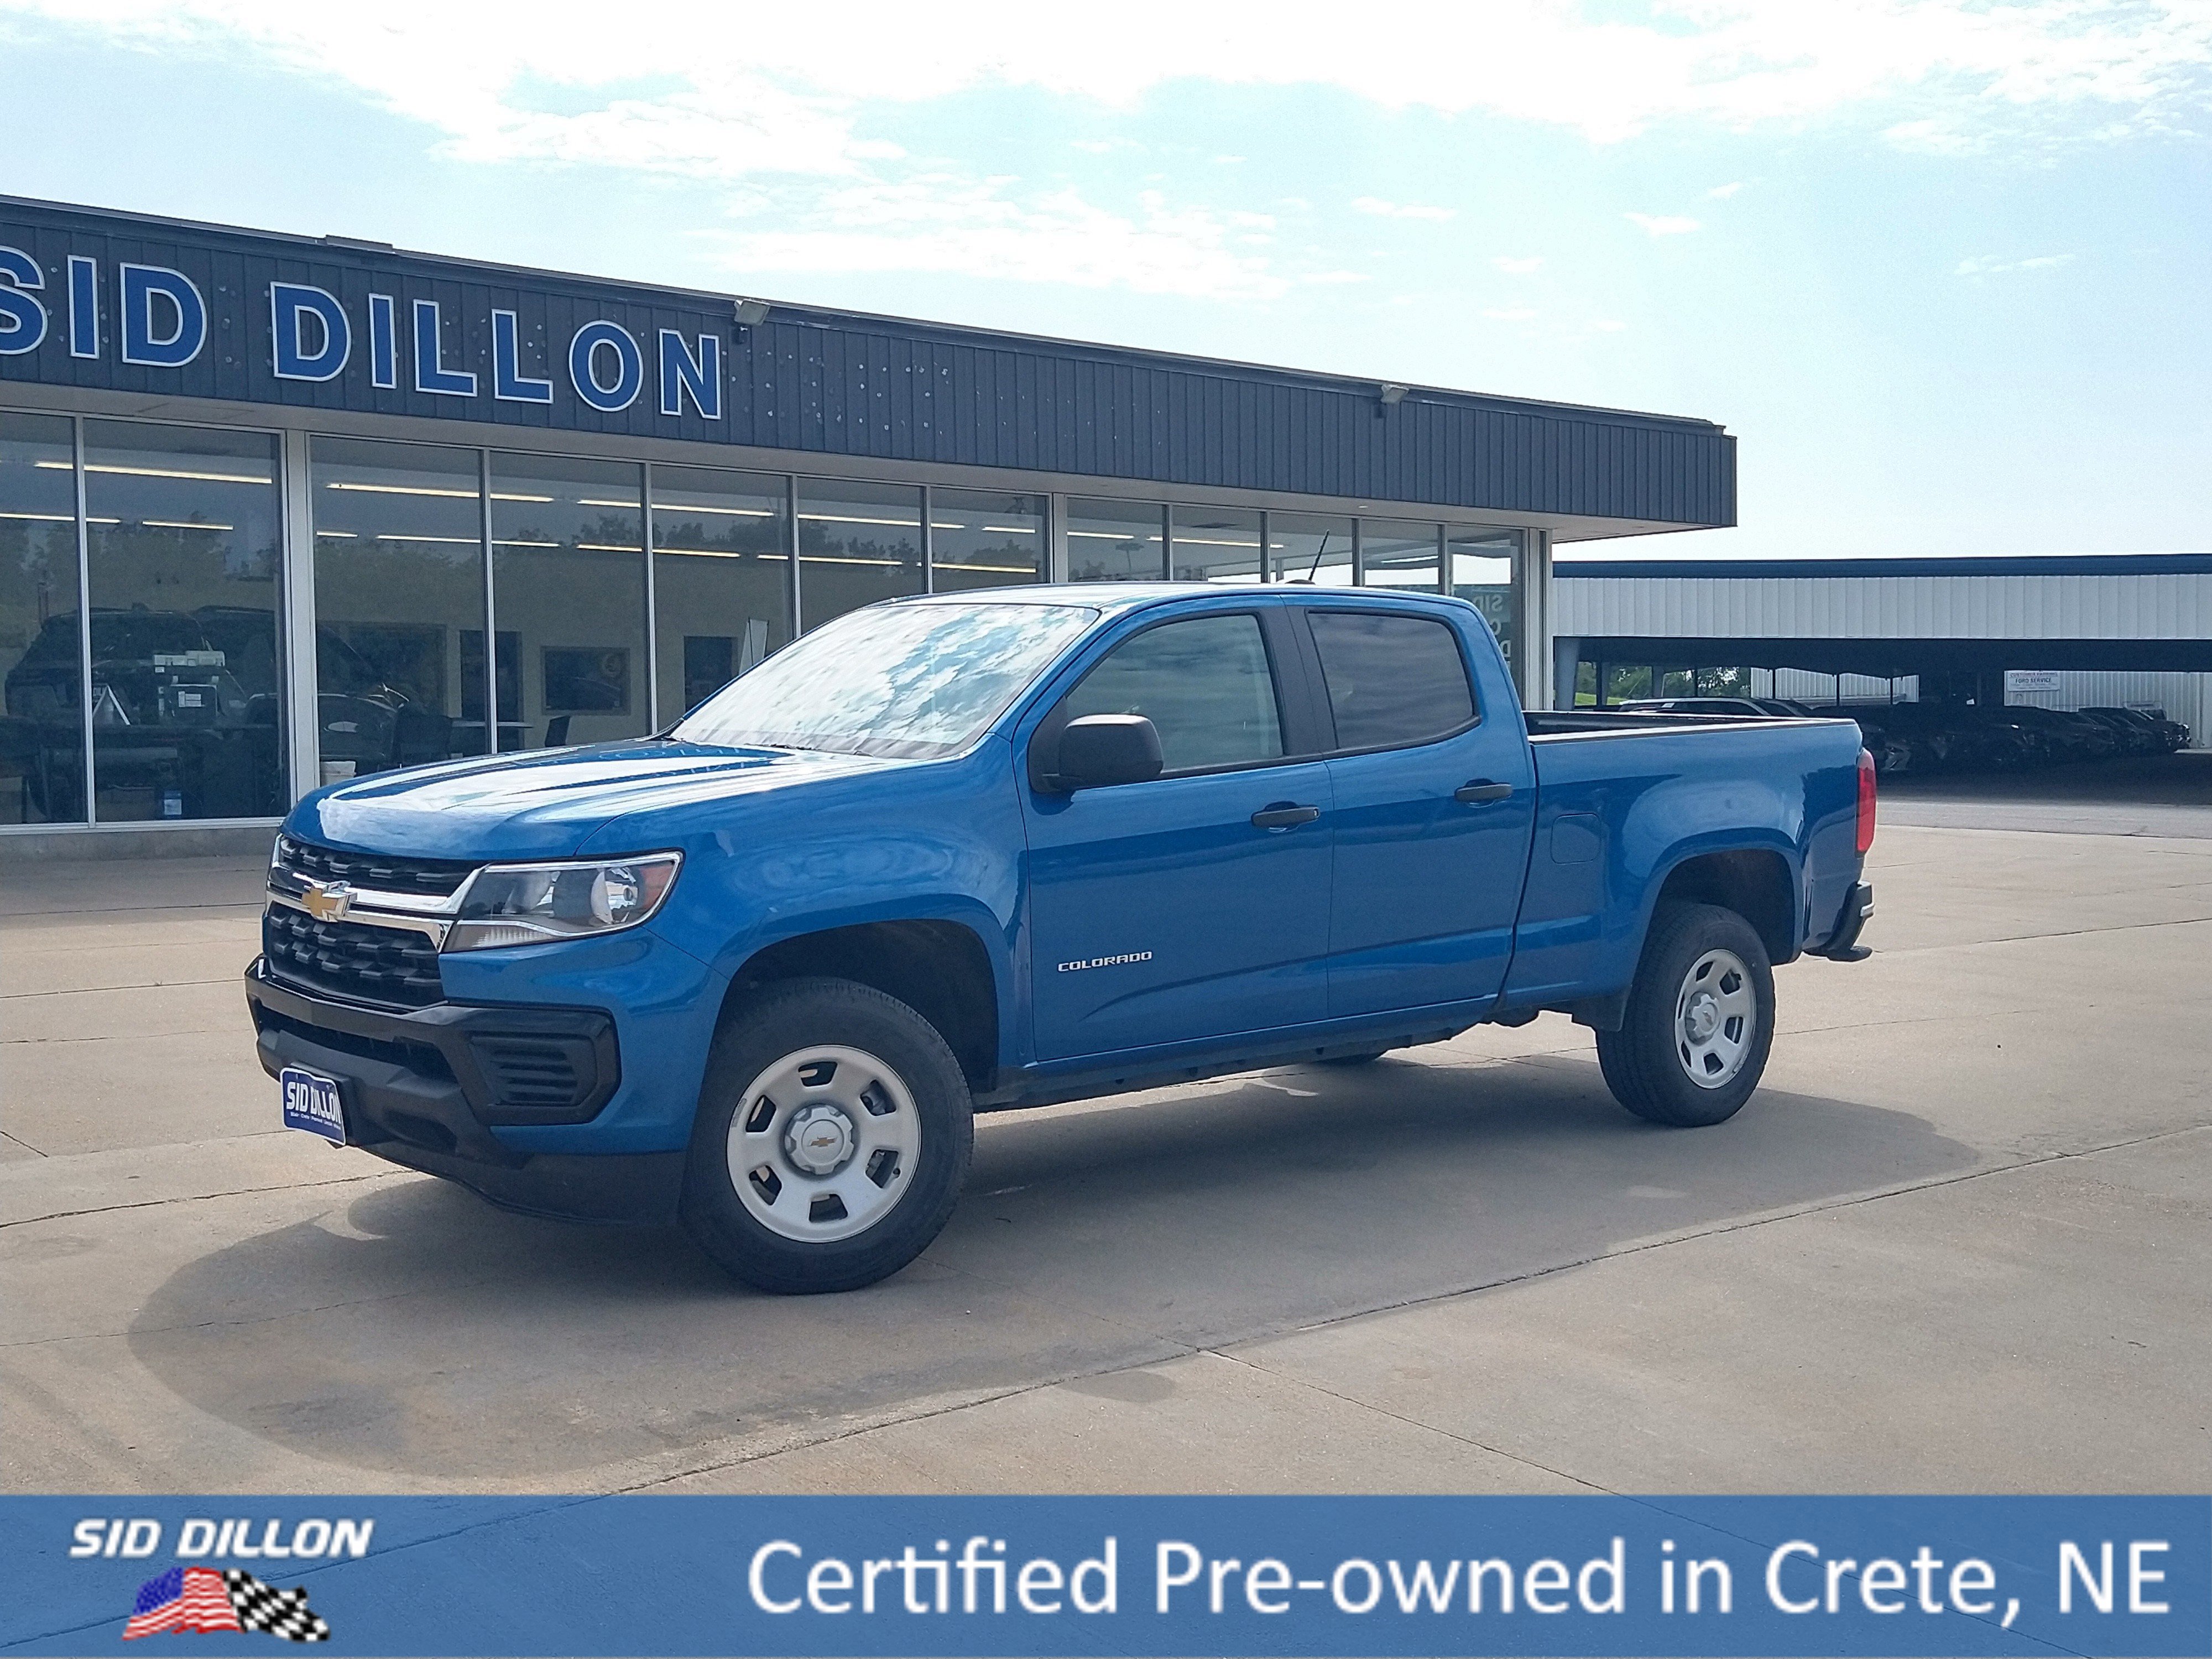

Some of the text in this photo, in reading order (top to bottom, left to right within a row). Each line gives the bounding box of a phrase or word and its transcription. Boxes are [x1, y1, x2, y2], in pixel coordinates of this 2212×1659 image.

[0, 245, 722, 420] SID DILLON
[1058, 951, 1152, 972] COLORADO
[286, 1082, 341, 1124] SID DILLON
